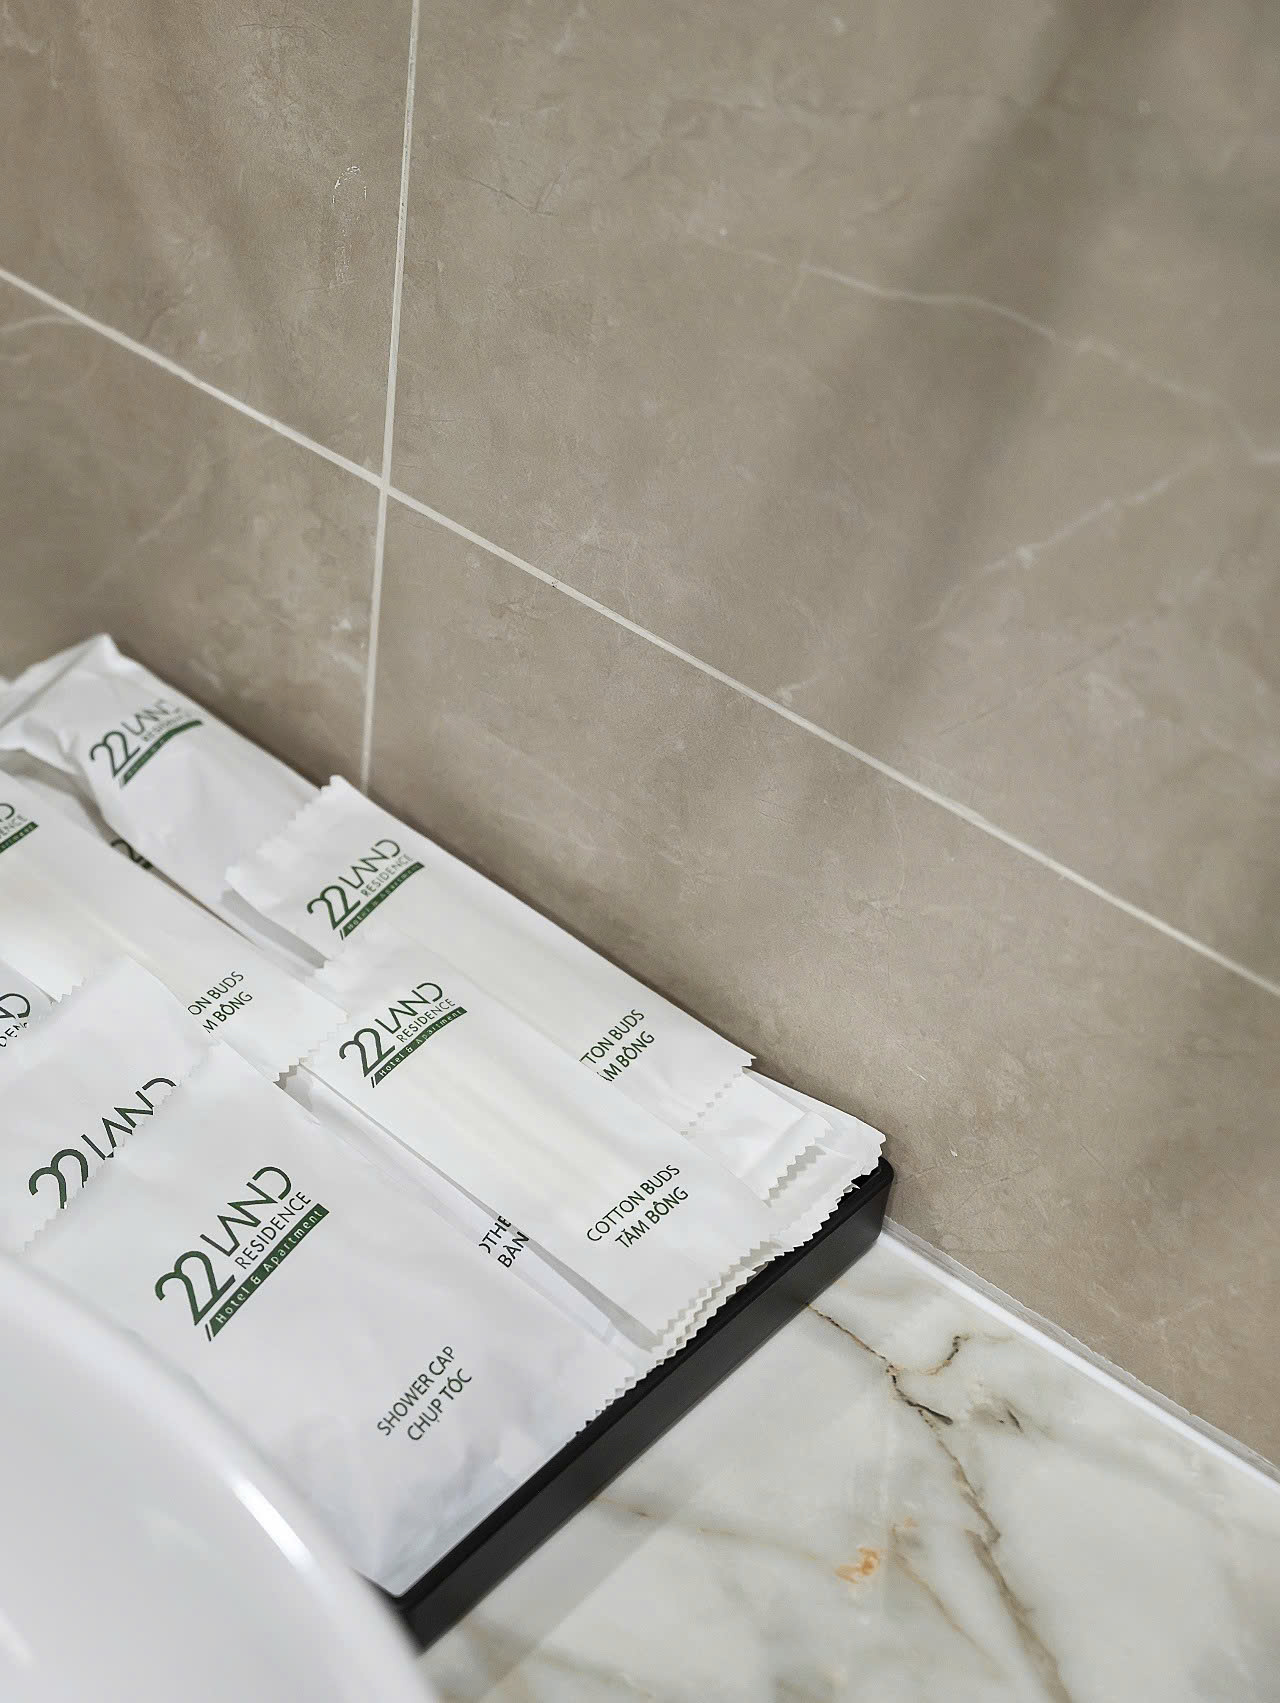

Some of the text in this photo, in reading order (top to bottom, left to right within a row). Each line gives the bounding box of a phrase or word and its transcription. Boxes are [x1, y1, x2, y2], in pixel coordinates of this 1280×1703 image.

[89, 731, 141, 778] 22
[306, 839, 401, 930] 22 LAND
[360, 853, 414, 897] RESIDENCE
[206, 971, 244, 999] BUDS
[212, 991, 253, 1022] BÔNG
[339, 982, 443, 1078] 22 LAND
[378, 1053, 404, 1077] Hotel
[416, 1010, 462, 1045] Apartment
[396, 998, 456, 1042] RESIDENCE
[608, 1009, 645, 1040] BUDS
[615, 1031, 655, 1068] BÔNG
[586, 1164, 680, 1242] COTTON BUDS
[614, 1186, 689, 1248] TĂM BÔNG
[155, 1166, 291, 1326] 22 LAND
[234, 1191, 312, 1270] RESIDENCE
[497, 1231, 530, 1268] BÀN
[215, 1210, 323, 1324] Hotel & Apartment
[376, 1345, 455, 1436] SHOWER CAP
[438, 1367, 472, 1400] TÓC
